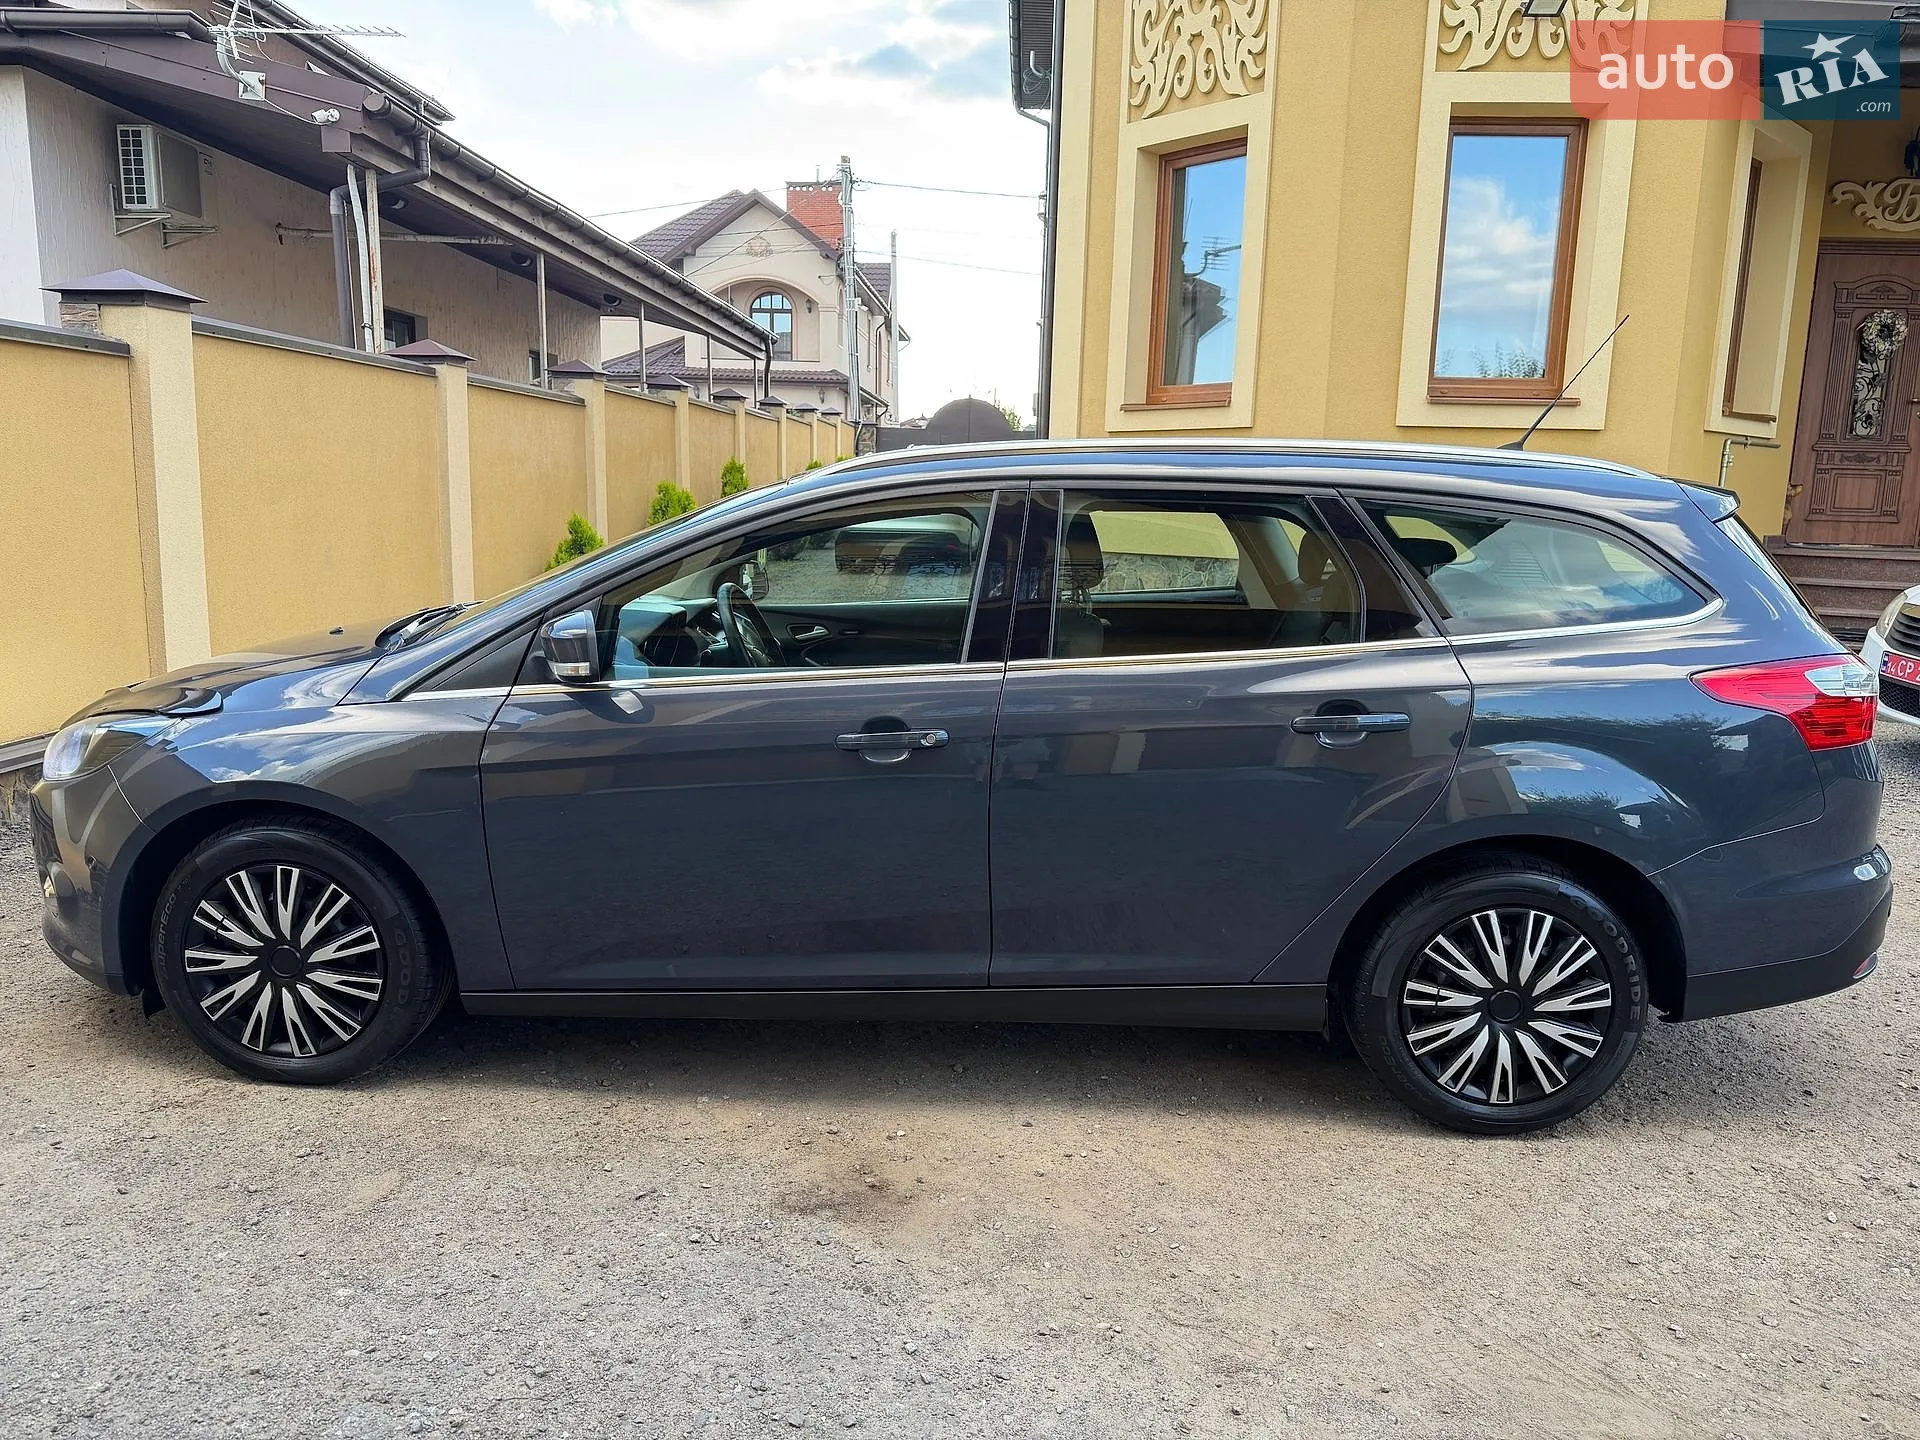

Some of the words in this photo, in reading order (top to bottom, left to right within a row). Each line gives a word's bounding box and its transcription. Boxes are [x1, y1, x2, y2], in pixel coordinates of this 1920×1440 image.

[1897, 660, 1914, 678] CP
[158, 893, 177, 980] uperEco
[1570, 896, 1641, 1021] GOODRIDE
